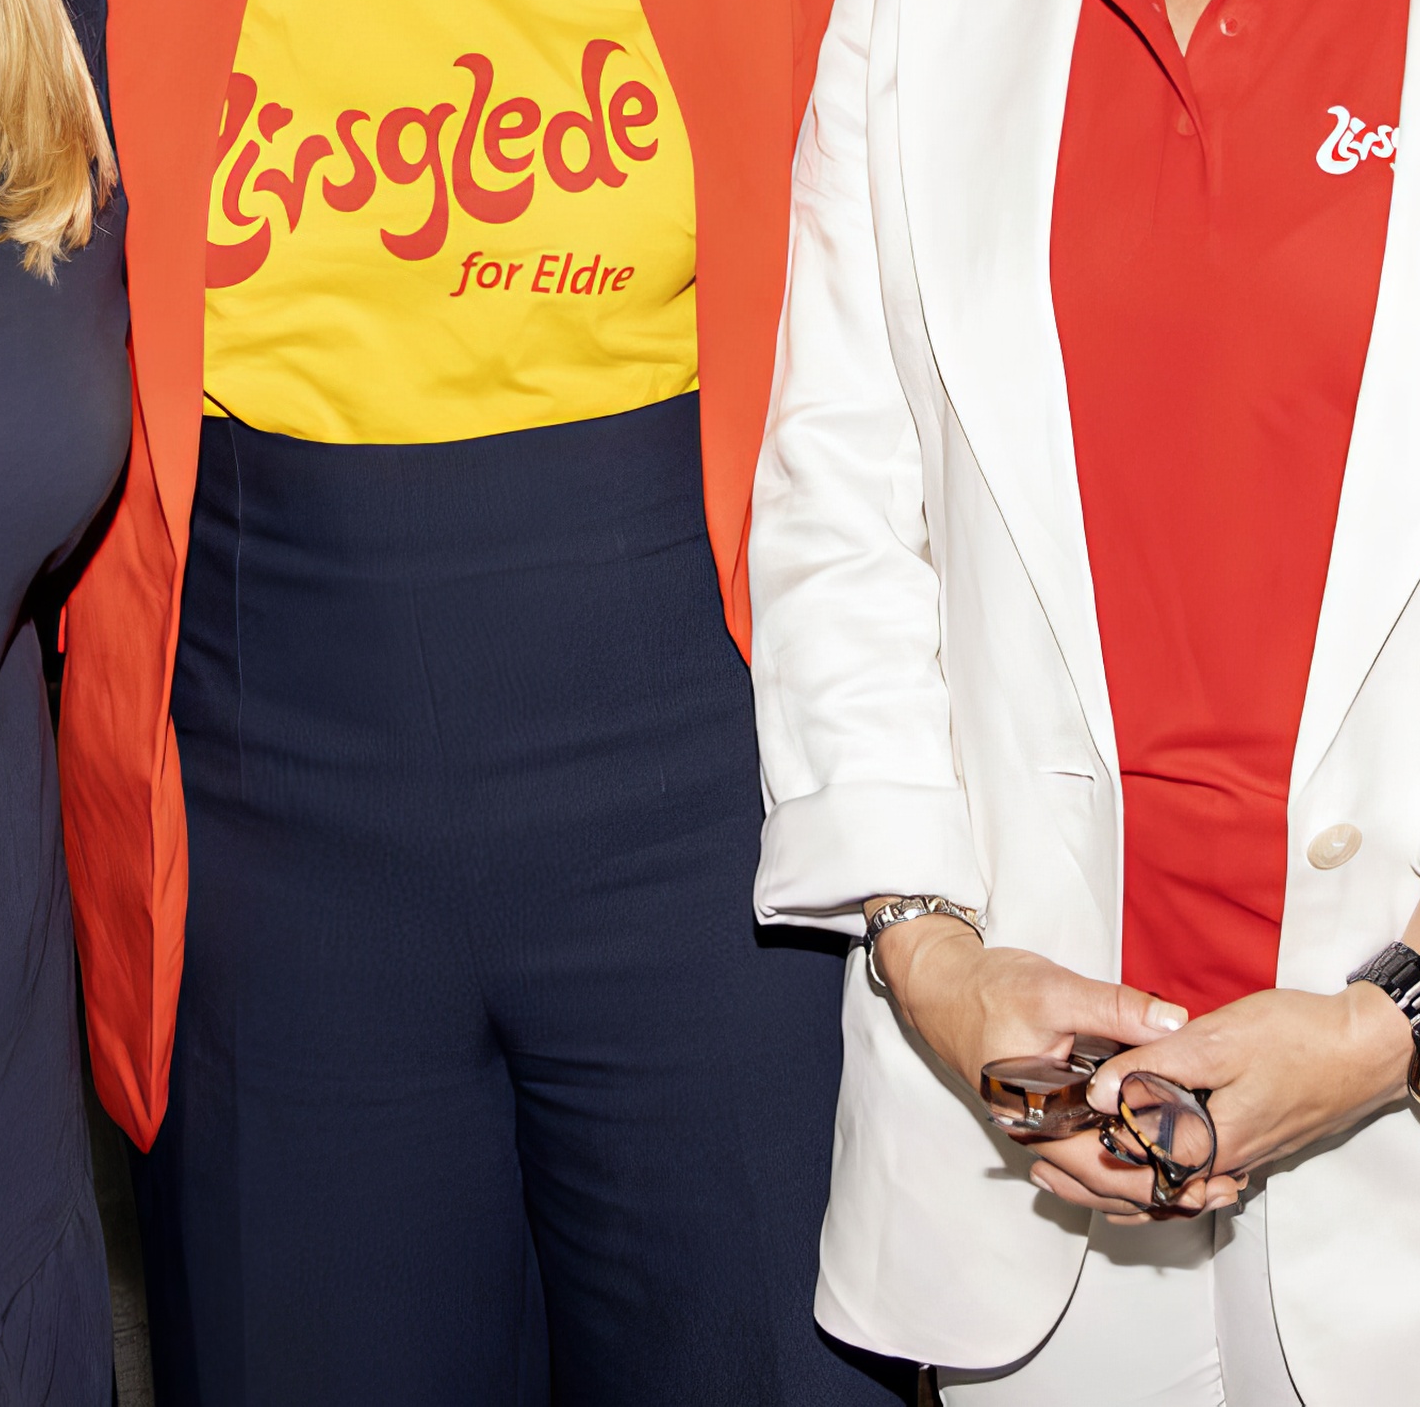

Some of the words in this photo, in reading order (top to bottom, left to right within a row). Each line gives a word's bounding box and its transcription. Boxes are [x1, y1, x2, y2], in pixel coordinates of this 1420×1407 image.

[1315, 105, 1400, 175] Livs
[449, 251, 524, 297] for
[531, 252, 636, 295] Eldre
